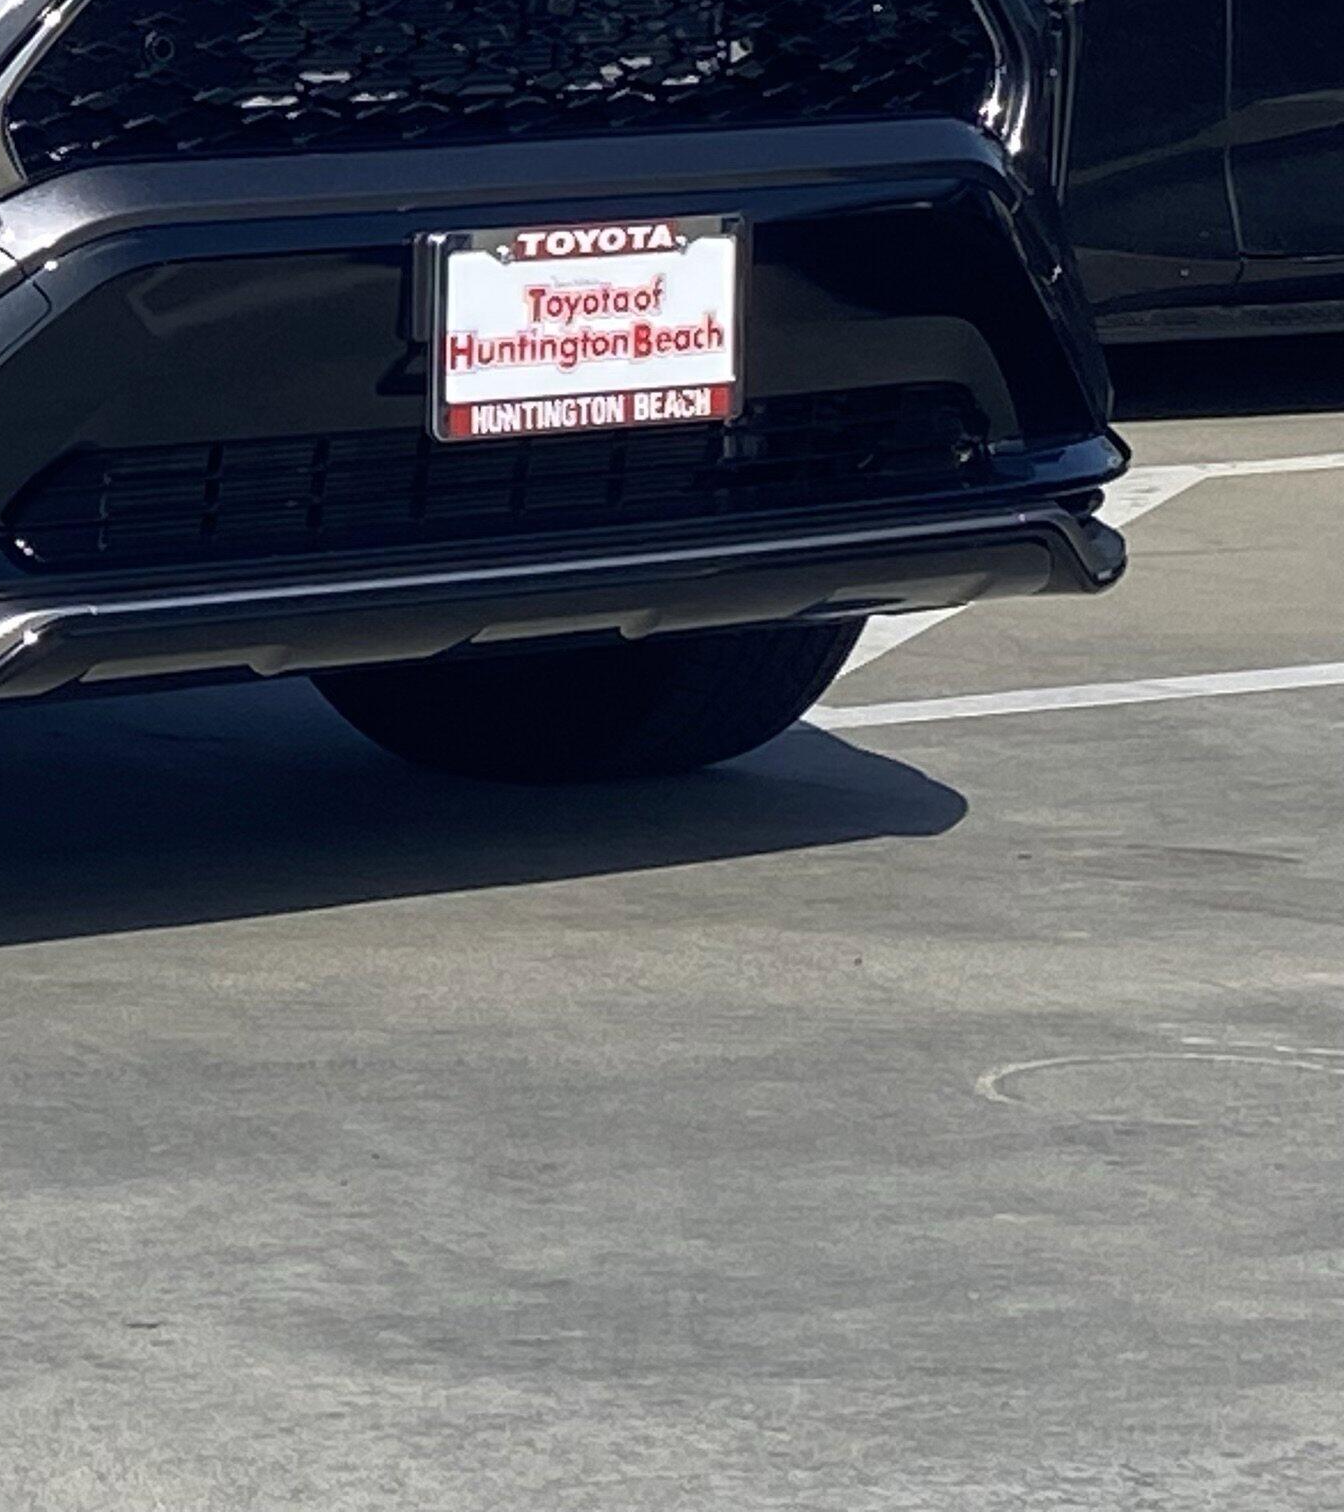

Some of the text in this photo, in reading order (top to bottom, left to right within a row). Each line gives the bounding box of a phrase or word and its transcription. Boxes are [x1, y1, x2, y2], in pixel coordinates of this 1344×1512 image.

[517, 224, 674, 256] TOYOTA
[528, 274, 663, 326] Toyota of
[449, 314, 724, 371] Huntington Beach
[470, 387, 712, 435] HUNTINGTON BEACH
